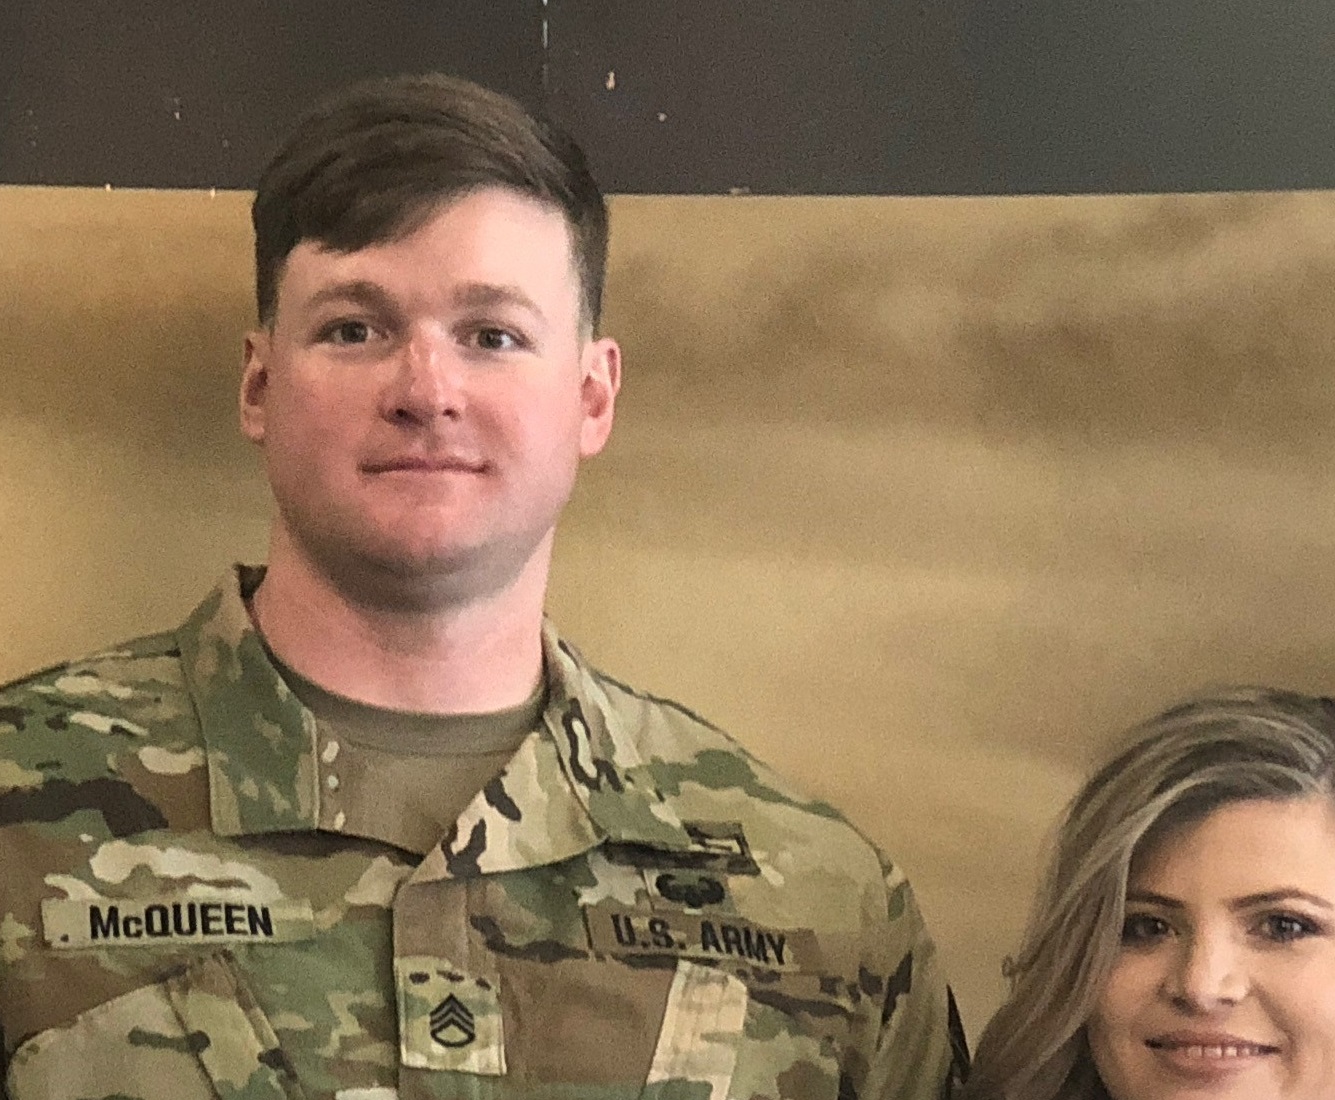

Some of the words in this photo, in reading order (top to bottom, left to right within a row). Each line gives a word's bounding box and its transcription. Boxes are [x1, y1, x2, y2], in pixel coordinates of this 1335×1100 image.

[89, 903, 273, 939] McQUEEN
[612, 914, 686, 950] U.S.
[701, 921, 785, 965] ARMY
